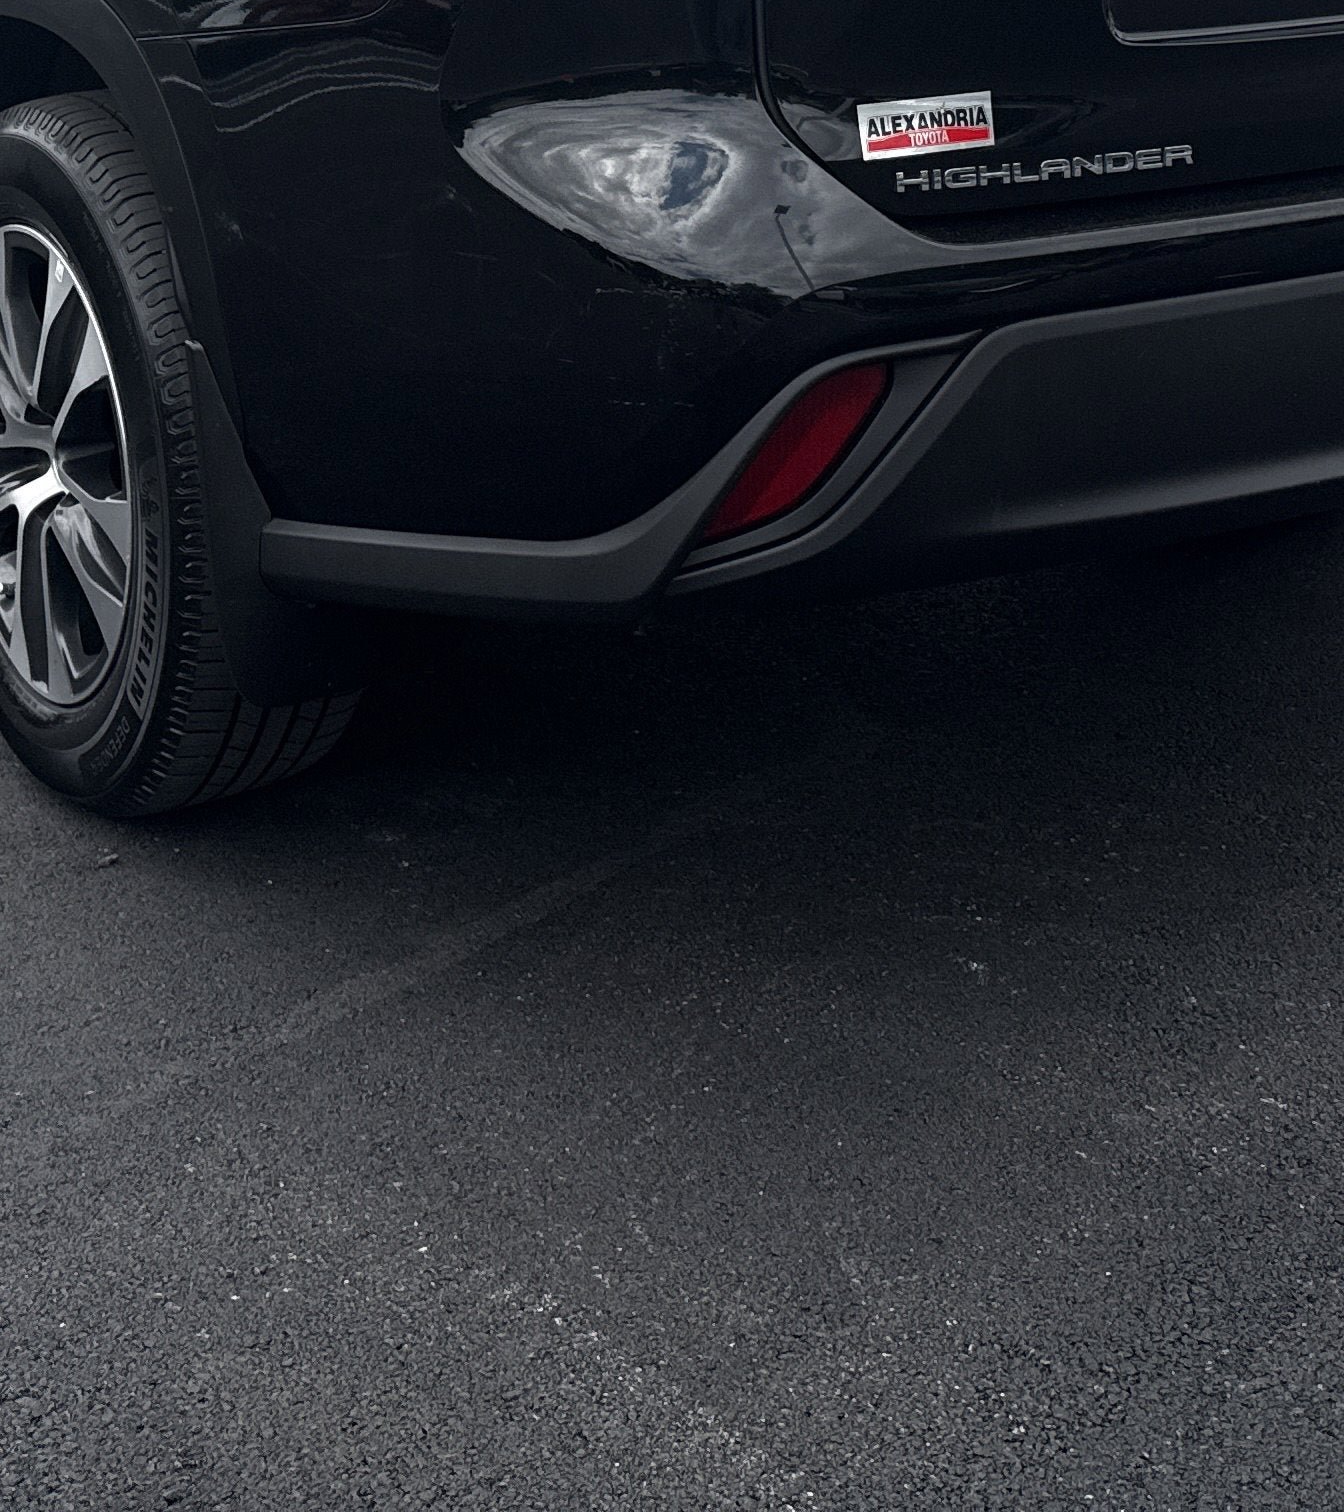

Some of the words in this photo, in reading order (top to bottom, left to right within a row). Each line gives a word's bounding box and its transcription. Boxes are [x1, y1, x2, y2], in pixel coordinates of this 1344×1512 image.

[867, 106, 988, 138] ALEXANDRIA
[909, 130, 950, 147] TOYOTA
[895, 144, 1194, 193] HIGHLANDER
[129, 527, 159, 710] MICHELIN
